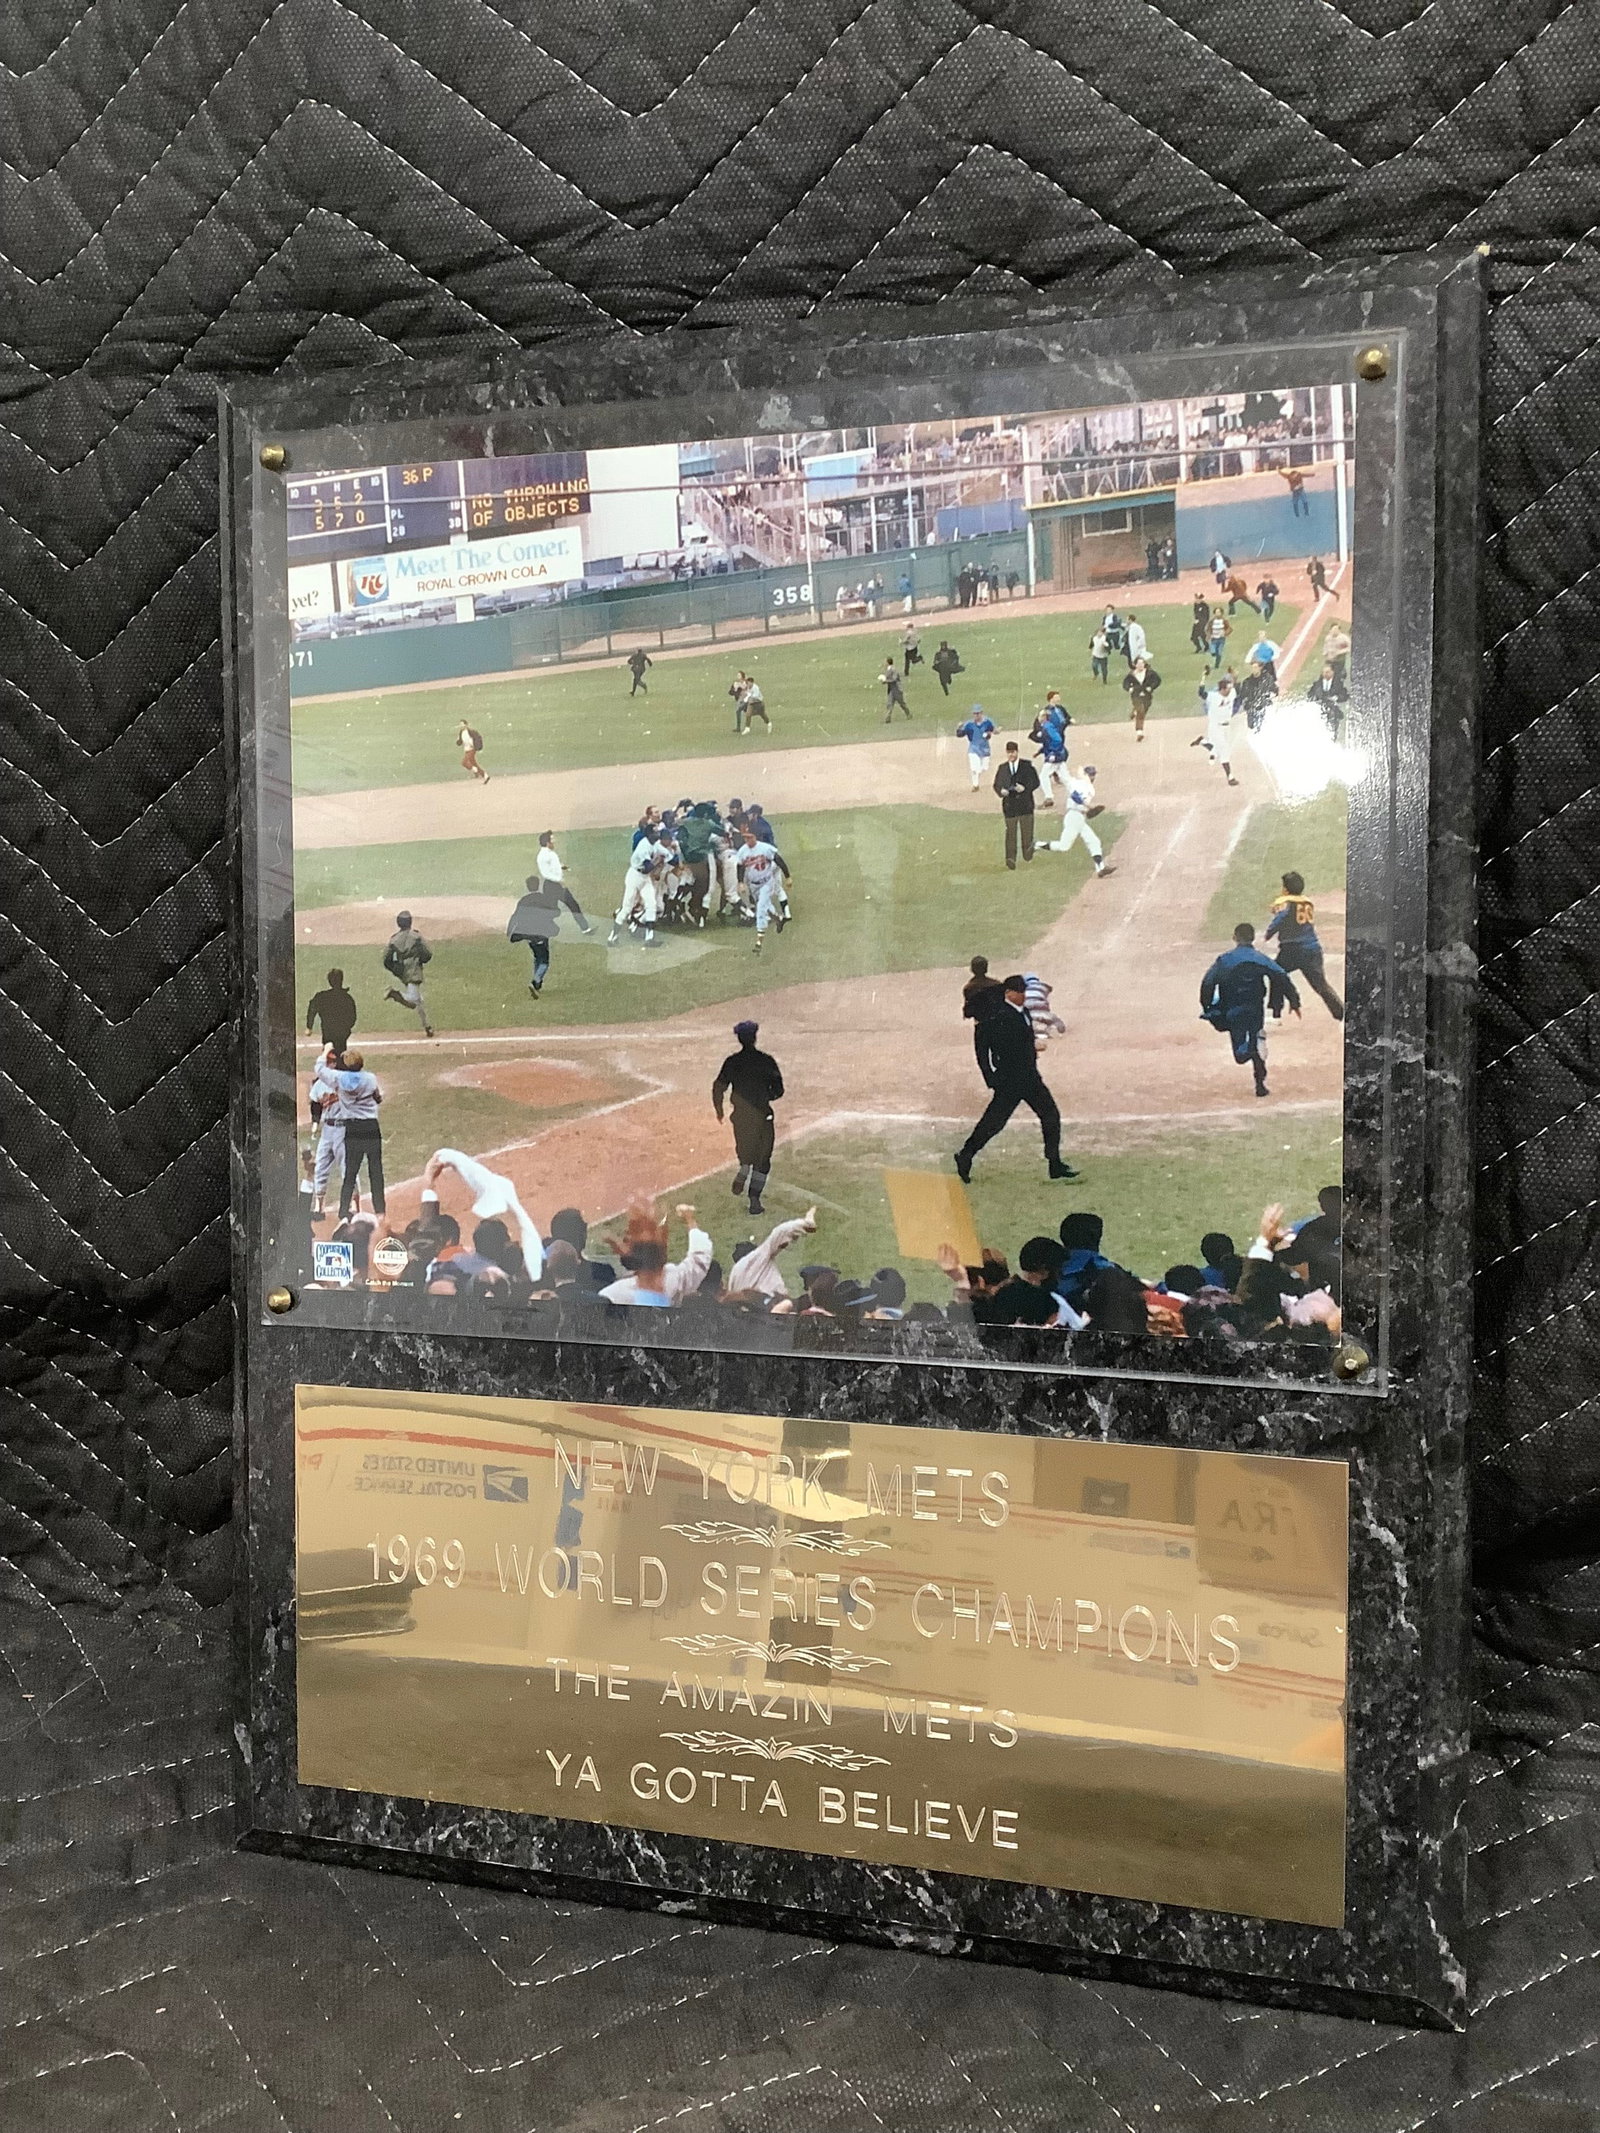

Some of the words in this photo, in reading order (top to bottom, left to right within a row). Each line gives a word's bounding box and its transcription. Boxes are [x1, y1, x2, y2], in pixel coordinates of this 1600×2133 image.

[353, 479, 360, 490] E
[403, 470, 419, 485] 36
[423, 467, 433, 482] P
[472, 493, 493, 509] NO
[504, 478, 589, 505] THROWING
[315, 516, 324, 530] 5
[335, 513, 344, 527] 7
[356, 510, 365, 524] 0
[473, 510, 494, 526] OF
[504, 497, 580, 523] OBJECTS
[396, 556, 447, 578] Meet
[455, 548, 491, 570] The
[417, 578, 454, 592] ROYAL
[459, 570, 507, 587] CROWN
[511, 564, 548, 580] COLA
[772, 584, 812, 606] 358
[316, 1265, 351, 1279] COLLECTION
[554, 1438, 660, 1496] NEW
[690, 1447, 832, 1511] YORK
[866, 1463, 1010, 1528] METS
[366, 1532, 467, 1589] 1969
[494, 1542, 669, 1608] WORLD
[700, 1561, 877, 1631] SERIES
[911, 1582, 1242, 1672] CHAMPIONS
[546, 1656, 632, 1702] THE
[659, 1671, 833, 1727] AMAZIN
[884, 1694, 1020, 1748] METS
[545, 1749, 601, 1792] YA
[630, 1761, 789, 1818] GOTTA
[818, 1785, 1020, 1850] BELIEVE
